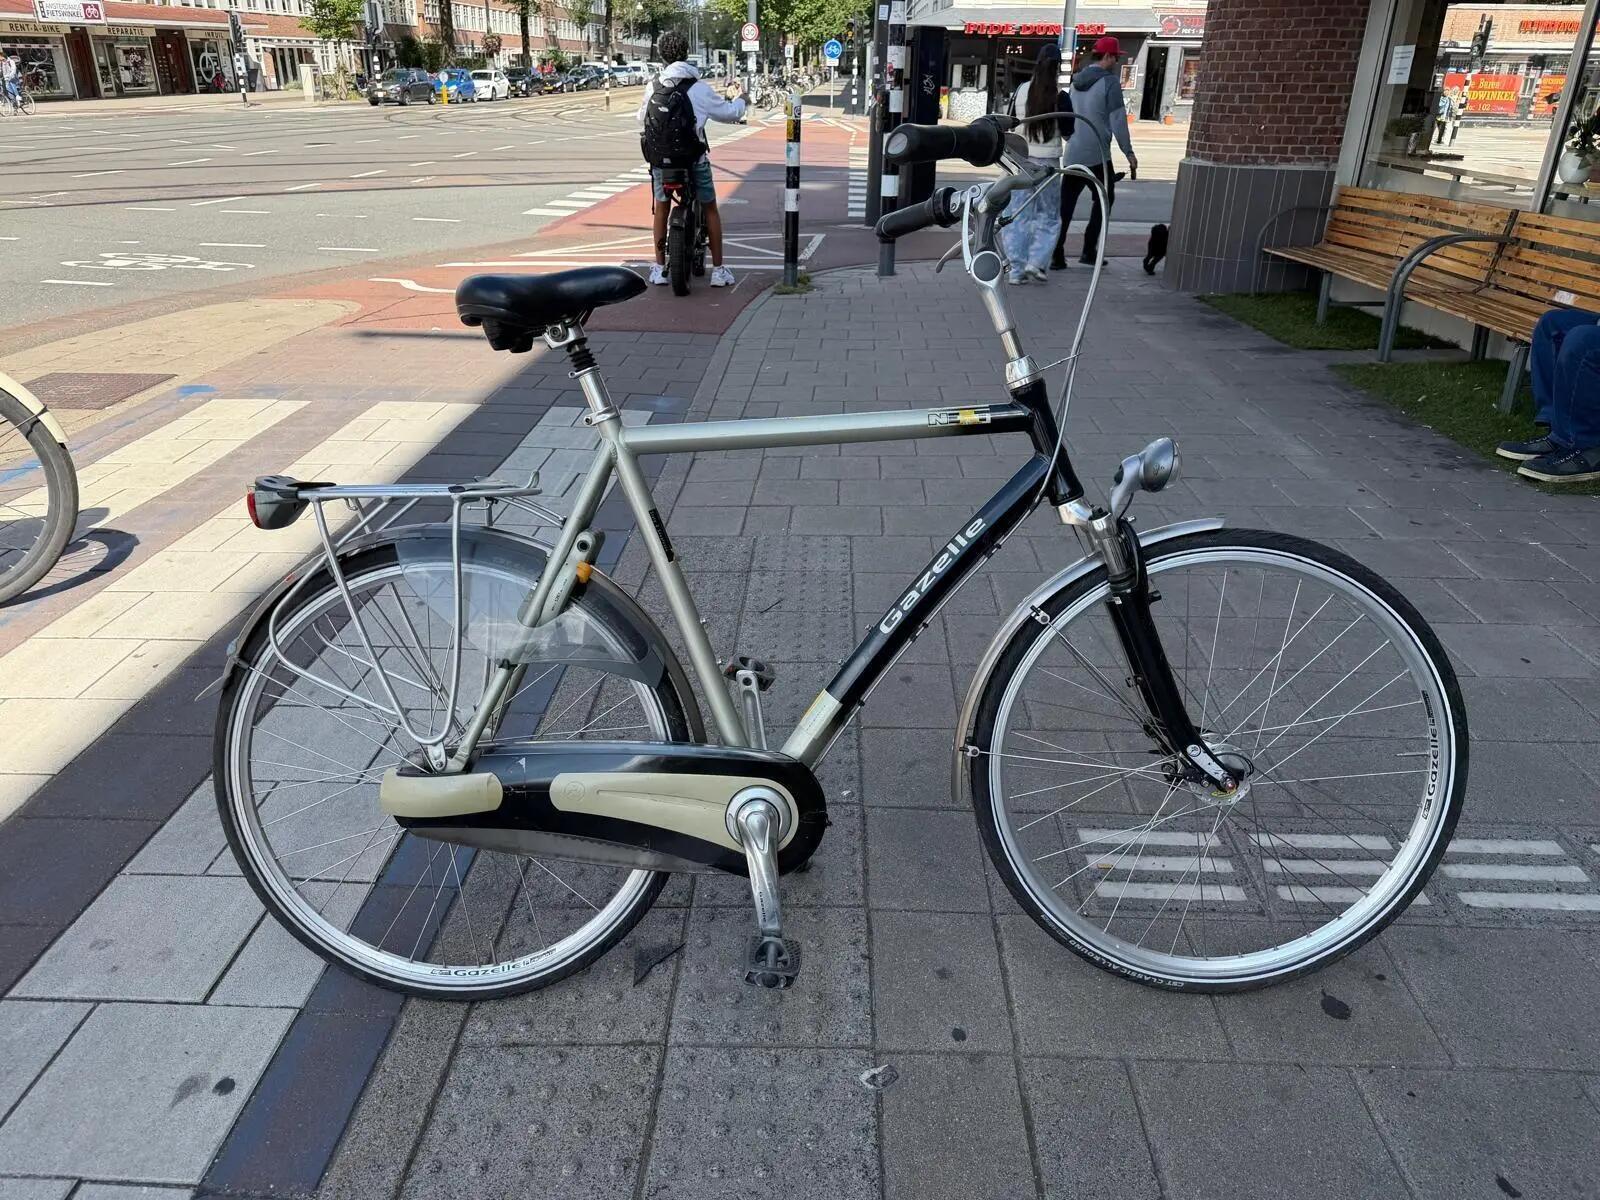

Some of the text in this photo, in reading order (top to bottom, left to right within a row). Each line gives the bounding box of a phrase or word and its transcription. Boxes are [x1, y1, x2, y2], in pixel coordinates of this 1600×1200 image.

[46, 9, 83, 18] FIETSWINKEL
[107, 27, 144, 36] REPARATIE
[879, 517, 987, 634] Gazelle
[1427, 728, 1439, 796] Gazelle
[453, 963, 522, 977] Gazelle
[1069, 939, 1185, 988] CST CLASSIC ALLROUND
